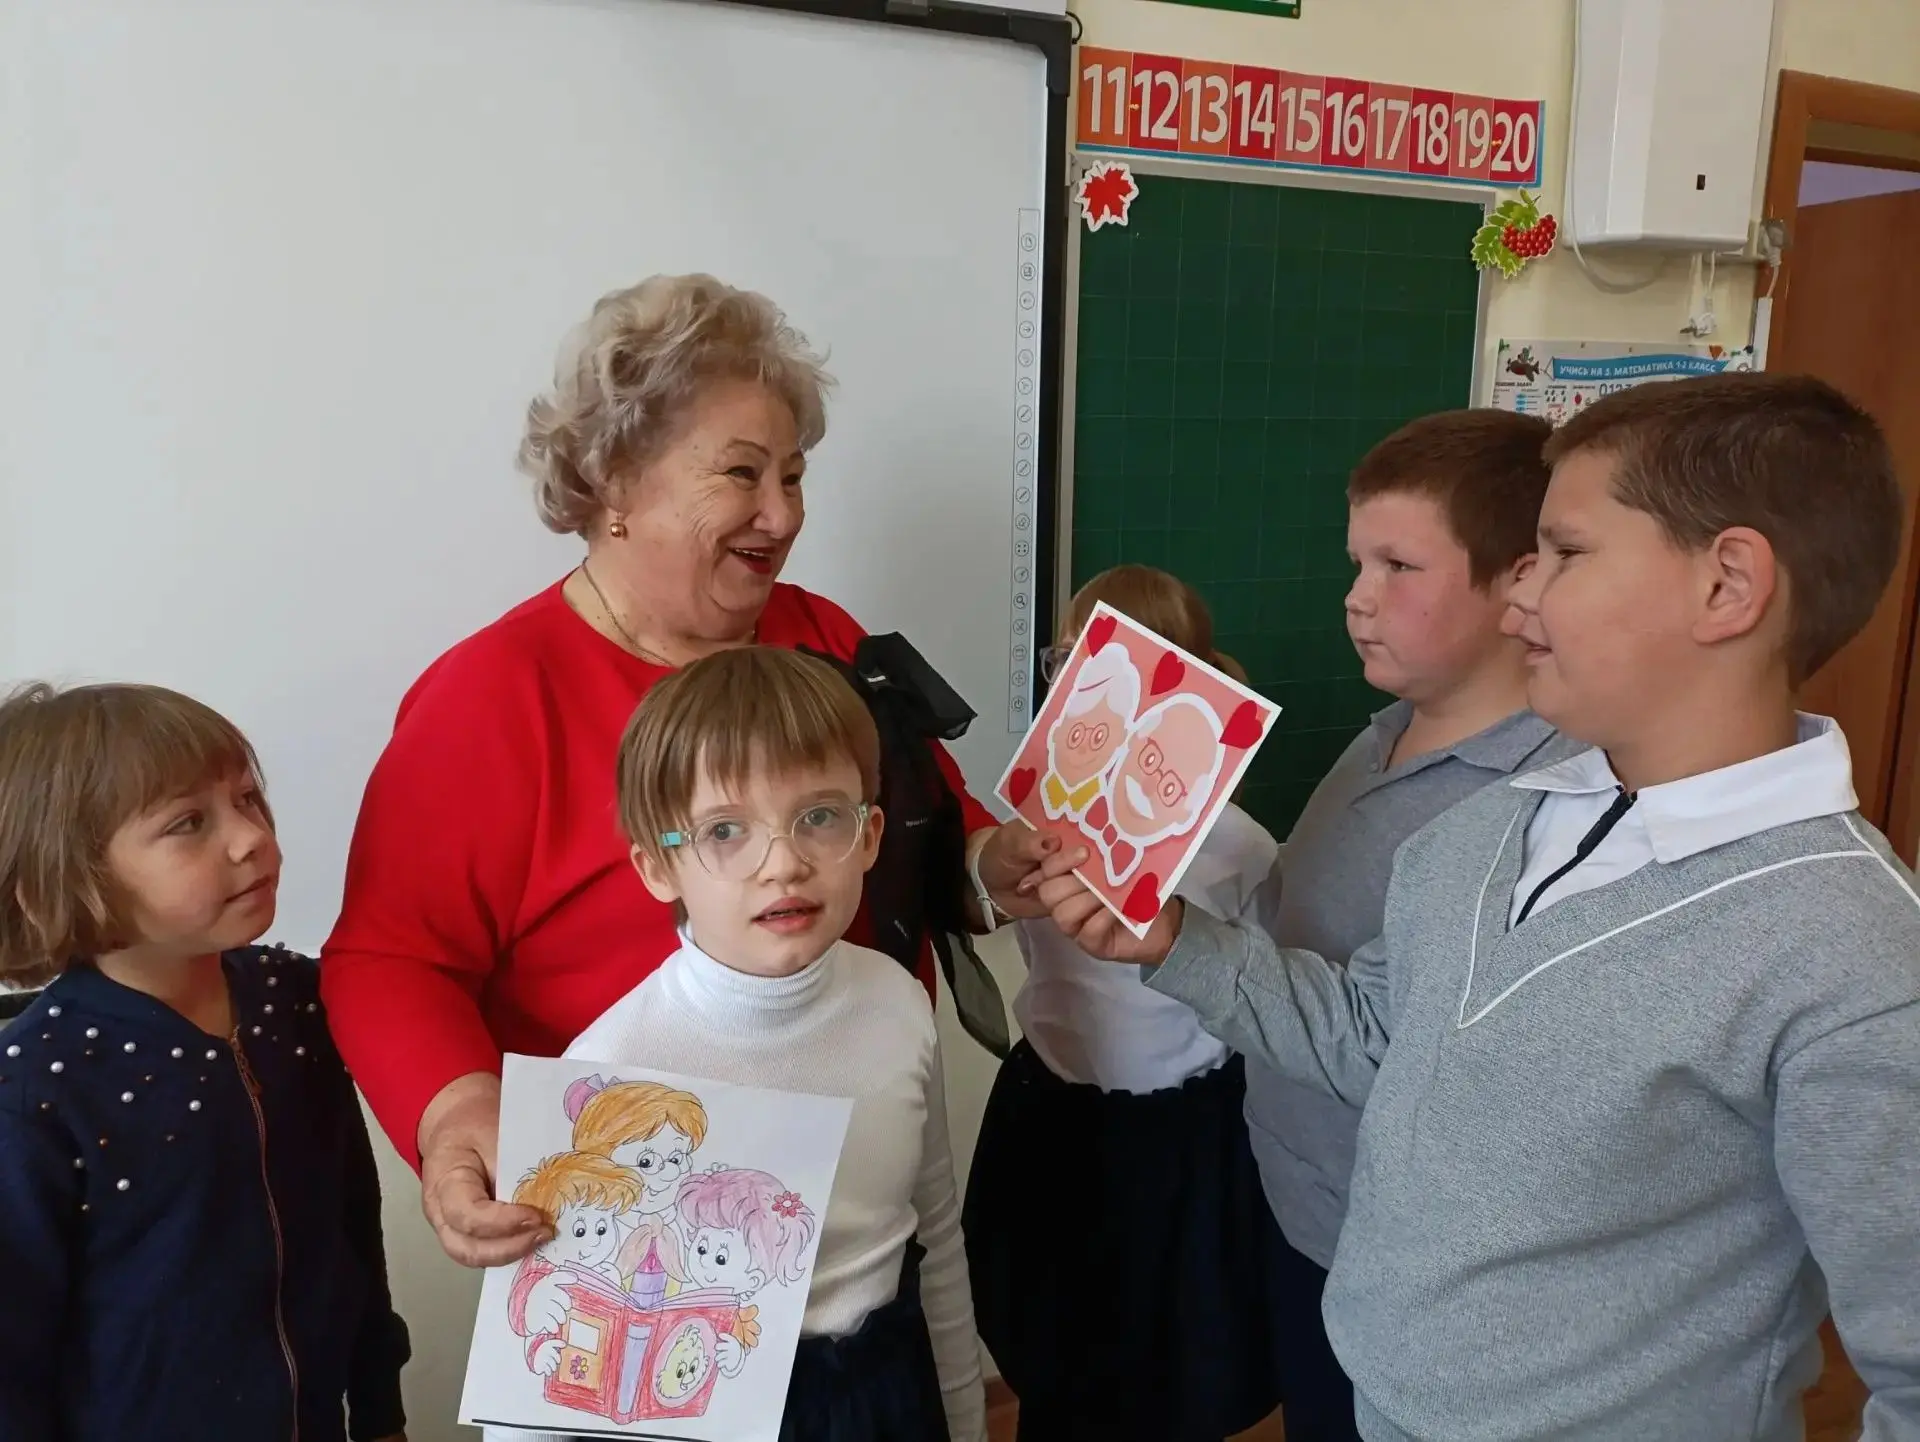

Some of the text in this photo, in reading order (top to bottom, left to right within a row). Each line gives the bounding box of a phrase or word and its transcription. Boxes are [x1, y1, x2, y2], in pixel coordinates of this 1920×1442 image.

[1083, 63, 1536, 172] 11 12 13 14 15 16 17 18 19 20
[1559, 366, 1589, 376] УЧИСЬ
[1590, 367, 1603, 376] НА
[1614, 361, 1673, 376] МАТЕМАТИКА
[1688, 361, 1716, 373] КЛАСС
